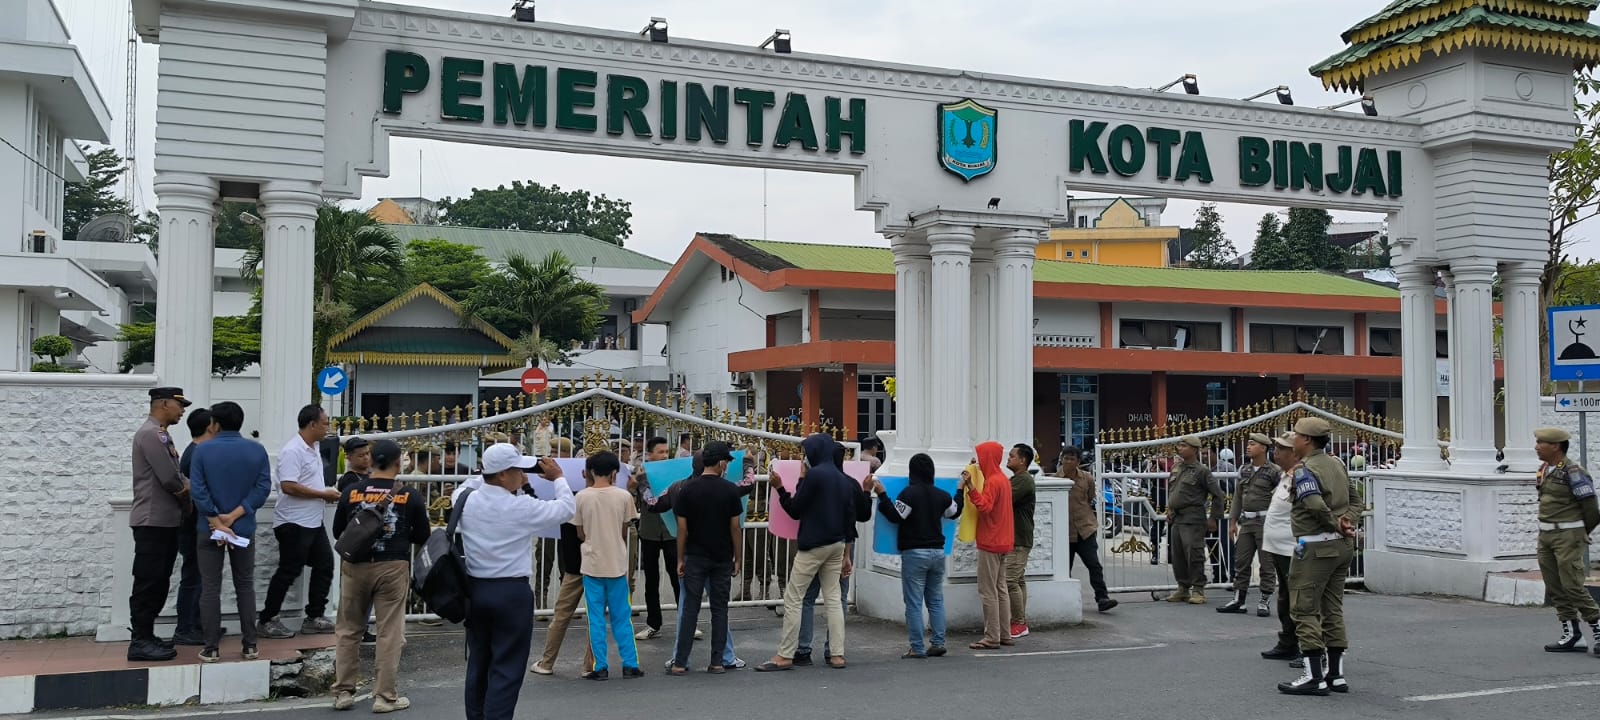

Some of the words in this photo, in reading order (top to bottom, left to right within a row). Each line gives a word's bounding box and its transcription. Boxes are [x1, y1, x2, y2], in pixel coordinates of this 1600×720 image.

[383, 49, 866, 154] PEMERINTAH
[1069, 119, 1214, 183] KOTA
[1238, 136, 1402, 197] BINJAI
[1128, 413, 1152, 422] DHAR
